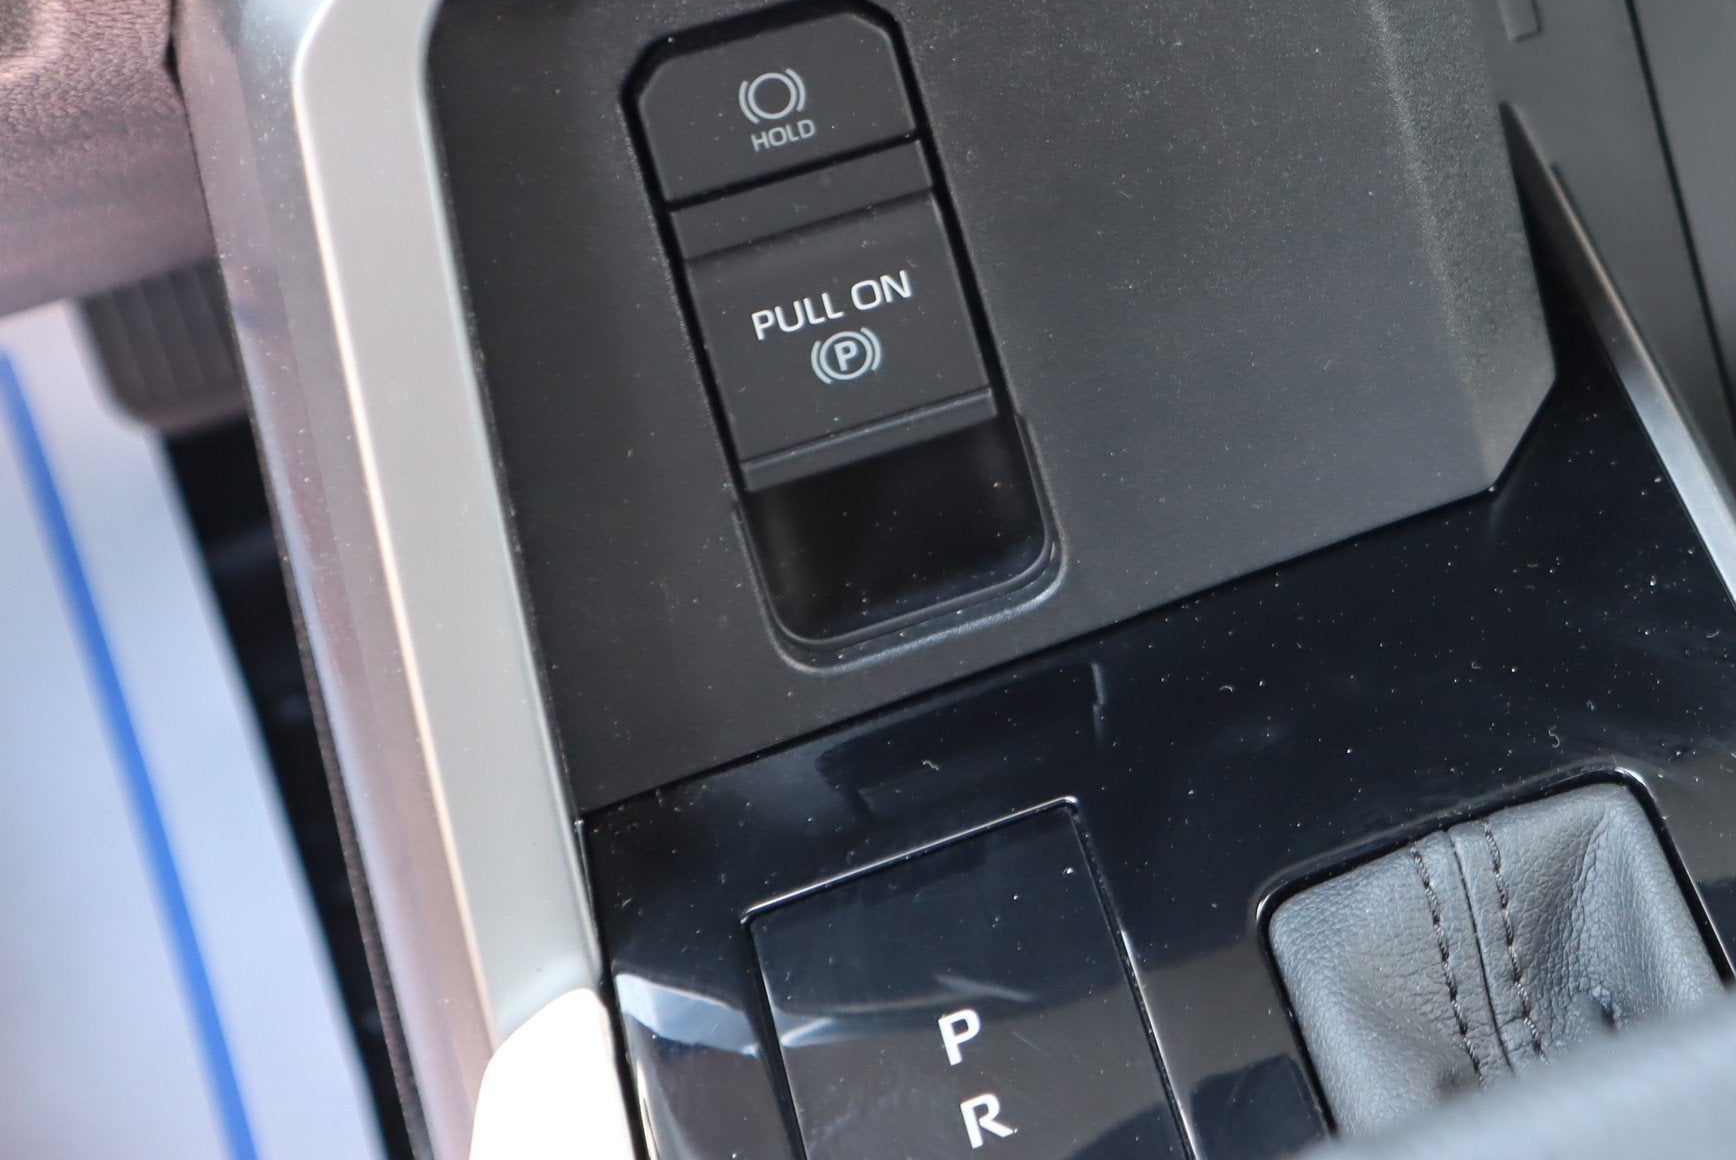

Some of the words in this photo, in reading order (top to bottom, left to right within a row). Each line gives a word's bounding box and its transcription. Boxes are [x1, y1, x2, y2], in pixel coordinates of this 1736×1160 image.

[751, 119, 816, 152] HOLD
[751, 292, 845, 341] PULL
[850, 269, 913, 311] ON
[834, 340, 858, 372] P
[938, 1008, 981, 1066] P
[960, 1093, 1015, 1150] R
